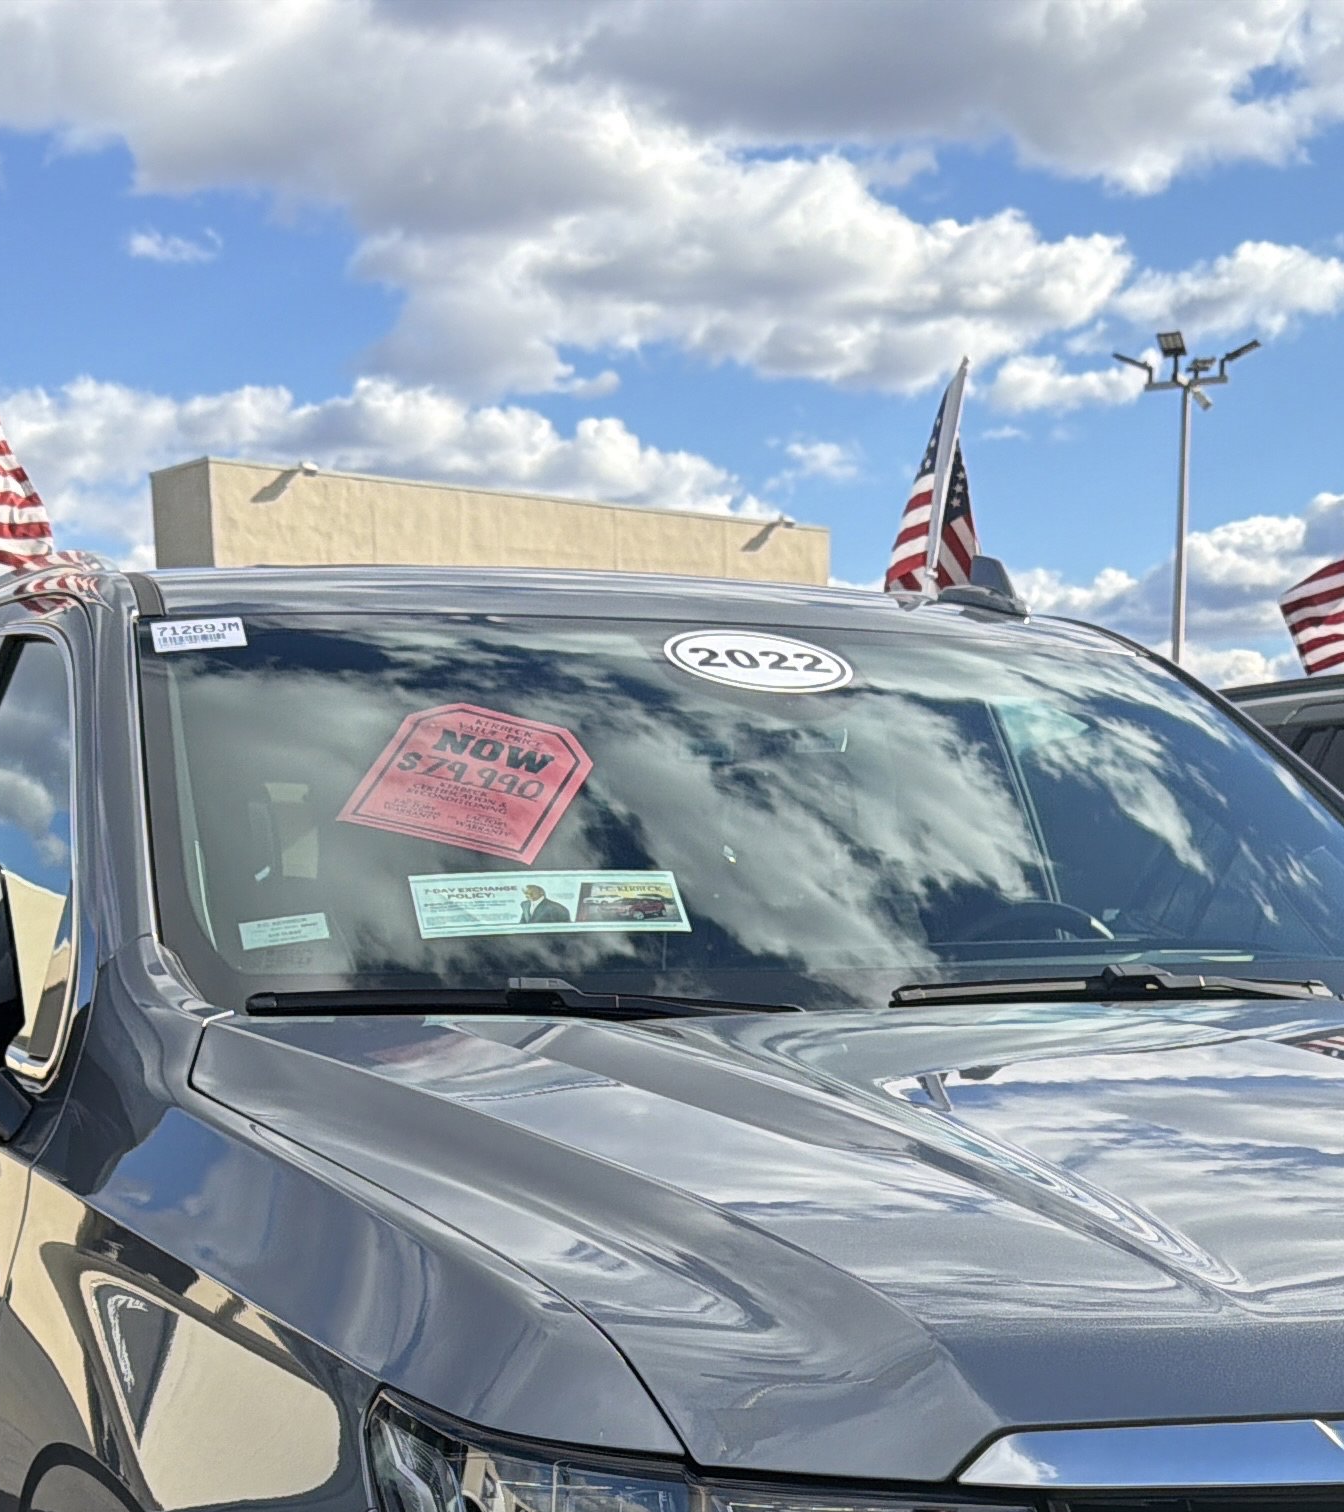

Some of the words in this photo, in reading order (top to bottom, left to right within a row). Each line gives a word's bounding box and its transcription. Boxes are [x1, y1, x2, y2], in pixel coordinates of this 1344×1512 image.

[157, 622, 240, 636] 71269JM
[689, 647, 833, 673] 2022
[432, 729, 555, 774] NOW
[457, 885, 517, 893] EXCHANGE
